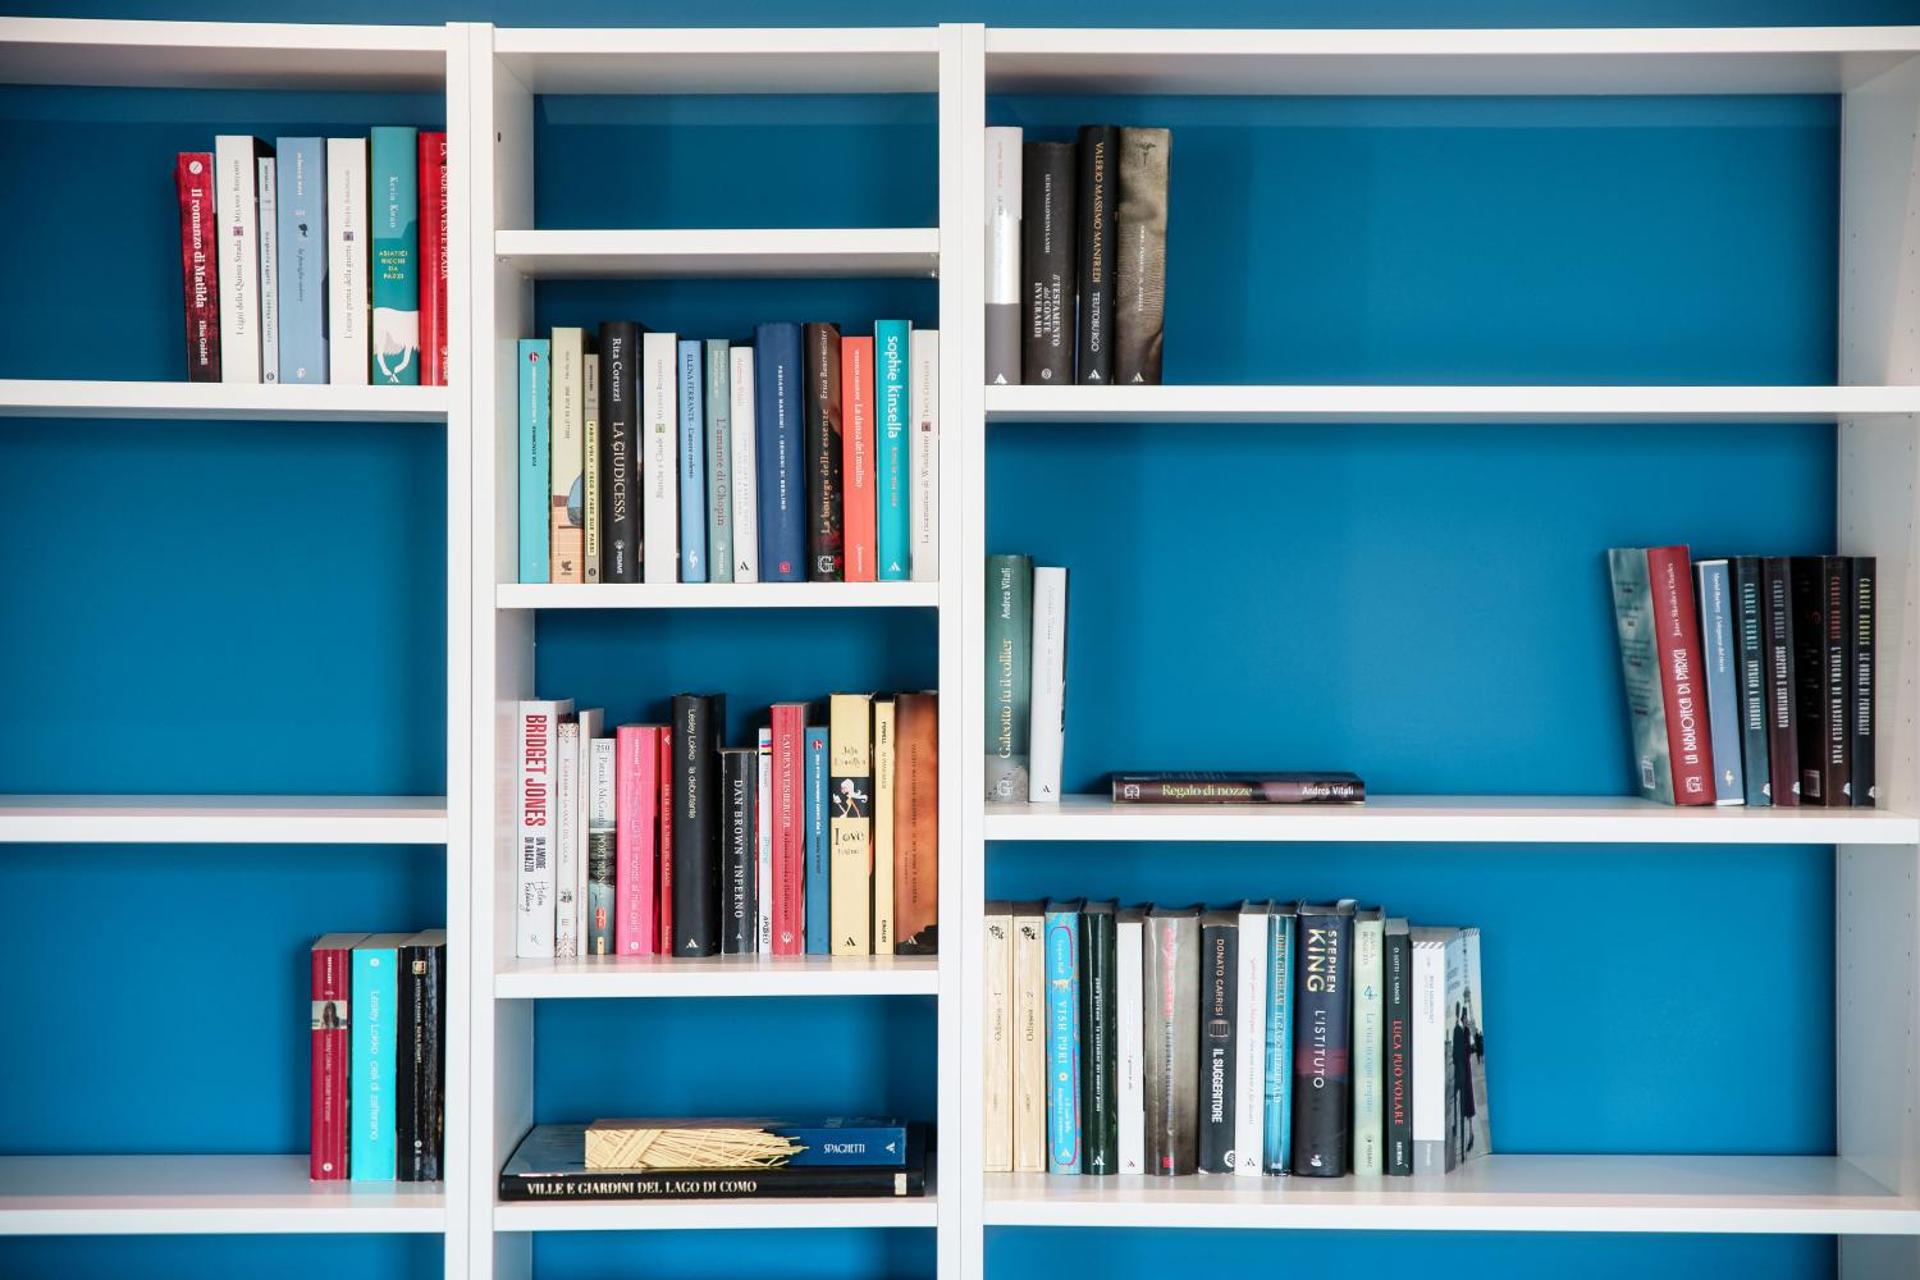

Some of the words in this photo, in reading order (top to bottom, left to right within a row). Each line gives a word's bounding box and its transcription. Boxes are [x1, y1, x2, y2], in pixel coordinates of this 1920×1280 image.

[1094, 142, 1104, 183] VALERIO
[191, 188, 203, 197] Il
[389, 176, 399, 202] Kevin
[390, 204, 399, 229] Kwan
[1093, 183, 1104, 229] MASSIMO
[191, 199, 202, 249] romanzo
[193, 251, 205, 263] di
[233, 239, 243, 262] Strada
[1092, 231, 1103, 283] MANFREDI
[194, 265, 207, 308] Matilda
[234, 264, 245, 292] Quinta
[234, 292, 244, 311] della
[1033, 282, 1043, 338] INVERARDI
[1042, 300, 1053, 333] CONTE
[1051, 281, 1061, 347] TESTAMENTO
[199, 320, 208, 337] Elisa
[1091, 291, 1101, 352] TEUTOBURGO
[612, 338, 622, 359] Rita
[884, 335, 901, 382] sophie
[612, 361, 622, 402] Coruzzi
[687, 380, 695, 422] FERRANTE
[854, 403, 864, 414] La
[886, 385, 903, 439] kinsella
[613, 422, 625, 436] LA
[715, 418, 727, 467] L'amante
[822, 408, 830, 448] essenze
[854, 415, 864, 440] danza
[820, 451, 831, 476] delle
[855, 440, 864, 456] del
[611, 441, 626, 523] GIUDICESSA
[717, 470, 726, 483] di
[855, 456, 865, 488] mulino
[714, 484, 727, 527] Chopin
[820, 480, 832, 518] bottega
[820, 520, 831, 534] La
[1000, 567, 1012, 590] Vitali
[1858, 578, 1870, 610] CARRIE
[1000, 591, 1012, 619] Andrea
[1744, 583, 1757, 614] CARRIE
[1745, 618, 1759, 651] BEBRIS
[1858, 614, 1870, 646] BEBRIS
[999, 638, 1012, 676] collier
[1673, 648, 1689, 680] PARIGI
[1775, 646, 1787, 679] SOSPETTO
[1831, 647, 1842, 683] L'ENIGMA
[1858, 653, 1870, 663] LE
[1000, 678, 1012, 688] il
[1676, 683, 1690, 695] DI
[1748, 660, 1760, 688] INTRIGO
[1858, 664, 1870, 686] OMBRE
[1000, 690, 1012, 703] fu
[1832, 686, 1842, 696] DI
[1858, 688, 1869, 696] DI
[686, 708, 697, 733] Lesley
[1776, 688, 1789, 728] SENTIMENTO
[1858, 698, 1870, 736] PEMBERLEY
[998, 706, 1012, 759] Galeotto
[1679, 698, 1697, 751] BIBLIOTECA
[525, 714, 548, 775] BRIDGET
[688, 736, 697, 760] Lokko
[1684, 754, 1698, 764] LA
[1832, 744, 1843, 764] PARK
[597, 756, 609, 786] Patrick
[688, 766, 697, 775] la
[525, 778, 548, 827] JONES
[688, 775, 697, 819] debuttante
[733, 780, 743, 806] DAN
[1162, 784, 1202, 798] Regalo
[1203, 784, 1214, 796] di
[1216, 787, 1253, 796] nozze
[1302, 786, 1331, 795] Andrea
[1332, 786, 1353, 796] Vitali
[597, 788, 609, 827] McGrath
[524, 836, 535, 844] DI
[535, 836, 546, 846] UN
[597, 835, 606, 858] PORT
[733, 811, 744, 855] BROWN
[524, 845, 535, 873] RAGAZZO
[535, 846, 547, 870] AMORE
[733, 864, 744, 919] INFERNO
[1214, 938, 1223, 977] DONATO
[1307, 928, 1325, 992] KING
[1327, 930, 1337, 993] STEPHEN
[1214, 978, 1223, 1016] CARRISI
[1275, 961, 1285, 1004] GRISHAM
[366, 990, 380, 1022] Lesley
[1057, 1000, 1067, 1031] VISH
[369, 1023, 380, 1054] Lokko
[1058, 1036, 1067, 1064] PURI
[1313, 1009, 1326, 1089] L'ISTITUTO
[1393, 1020, 1402, 1050] LUCA
[1211, 1048, 1223, 1058] IL
[1393, 1053, 1404, 1076] PUÒ
[1211, 1058, 1222, 1123] SUGGERITORE
[1394, 1079, 1404, 1126] VOLARE
[369, 1094, 380, 1140] zafferano
[823, 1143, 866, 1154] SPAGHETTI
[527, 1183, 564, 1195] VILLE
[566, 1183, 575, 1194] E
[577, 1182, 634, 1194] GIARDINI
[637, 1182, 663, 1193] DEL
[665, 1181, 700, 1193] LAGO
[703, 1181, 718, 1192] DI
[719, 1181, 757, 1192] COMO
